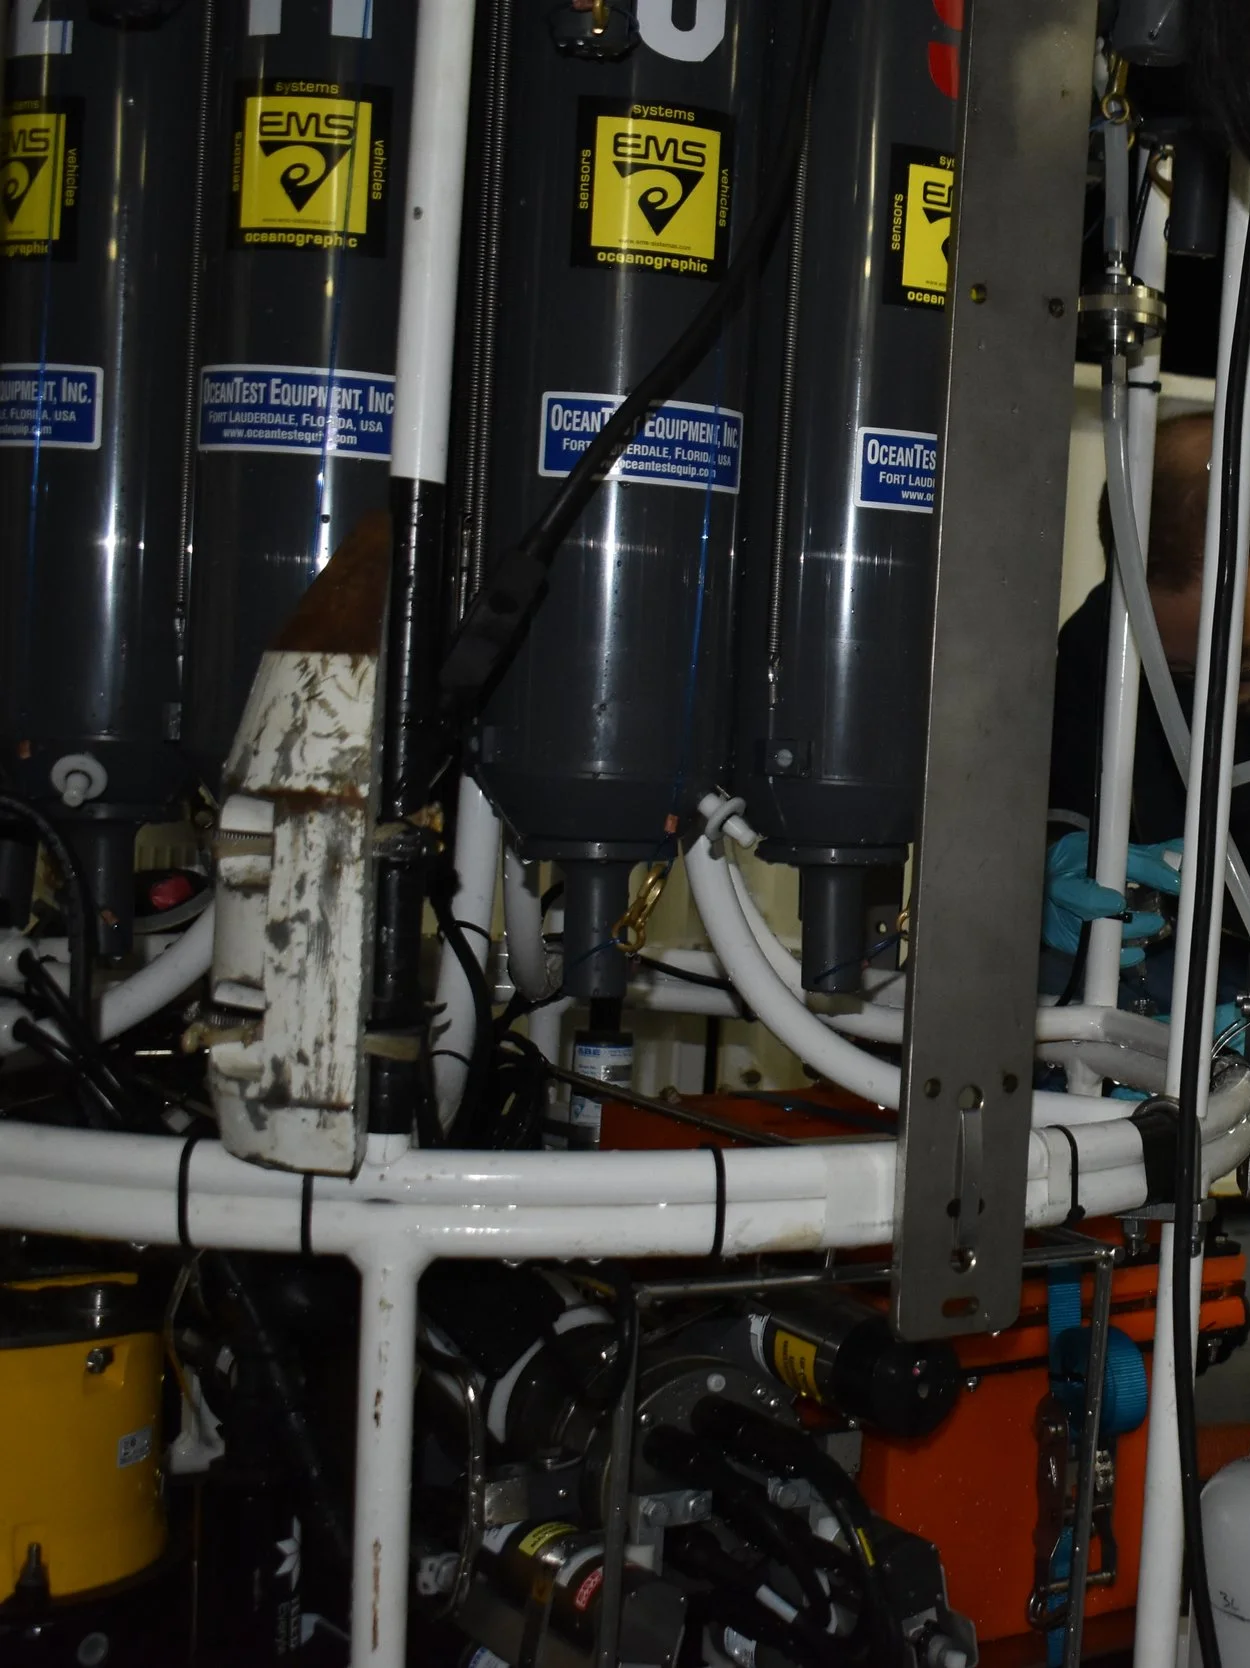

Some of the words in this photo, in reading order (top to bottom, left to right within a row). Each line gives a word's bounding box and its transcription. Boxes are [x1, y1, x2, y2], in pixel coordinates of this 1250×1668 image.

[275, 81, 340, 95] systems
[259, 111, 355, 140] EMS
[632, 103, 696, 122] systems
[2, 127, 50, 153] MS
[613, 132, 707, 168] EMS
[232, 131, 243, 193] sensors
[372, 139, 387, 201] vehicles
[65, 147, 80, 208] vehicles
[579, 149, 592, 210] sensors
[718, 168, 734, 228] vehicles
[891, 193, 904, 251] sensors
[244, 231, 359, 249] oceanographc
[596, 250, 709, 273] oceanographic
[61, 376, 93, 404] INC.
[54, 409, 77, 422] USA
[208, 410, 227, 424] FORT
[229, 410, 299, 427] LAUDERDALE,
[301, 413, 357, 432] FLODA,
[360, 420, 383, 433] USA
[222, 428, 358, 445] www.oceantestequicom
[717, 454, 732, 467] USA
[867, 438, 936, 471] OCEANTES
[879, 470, 907, 485] FORT
[1219, 1590, 1240, 1611] 3L
